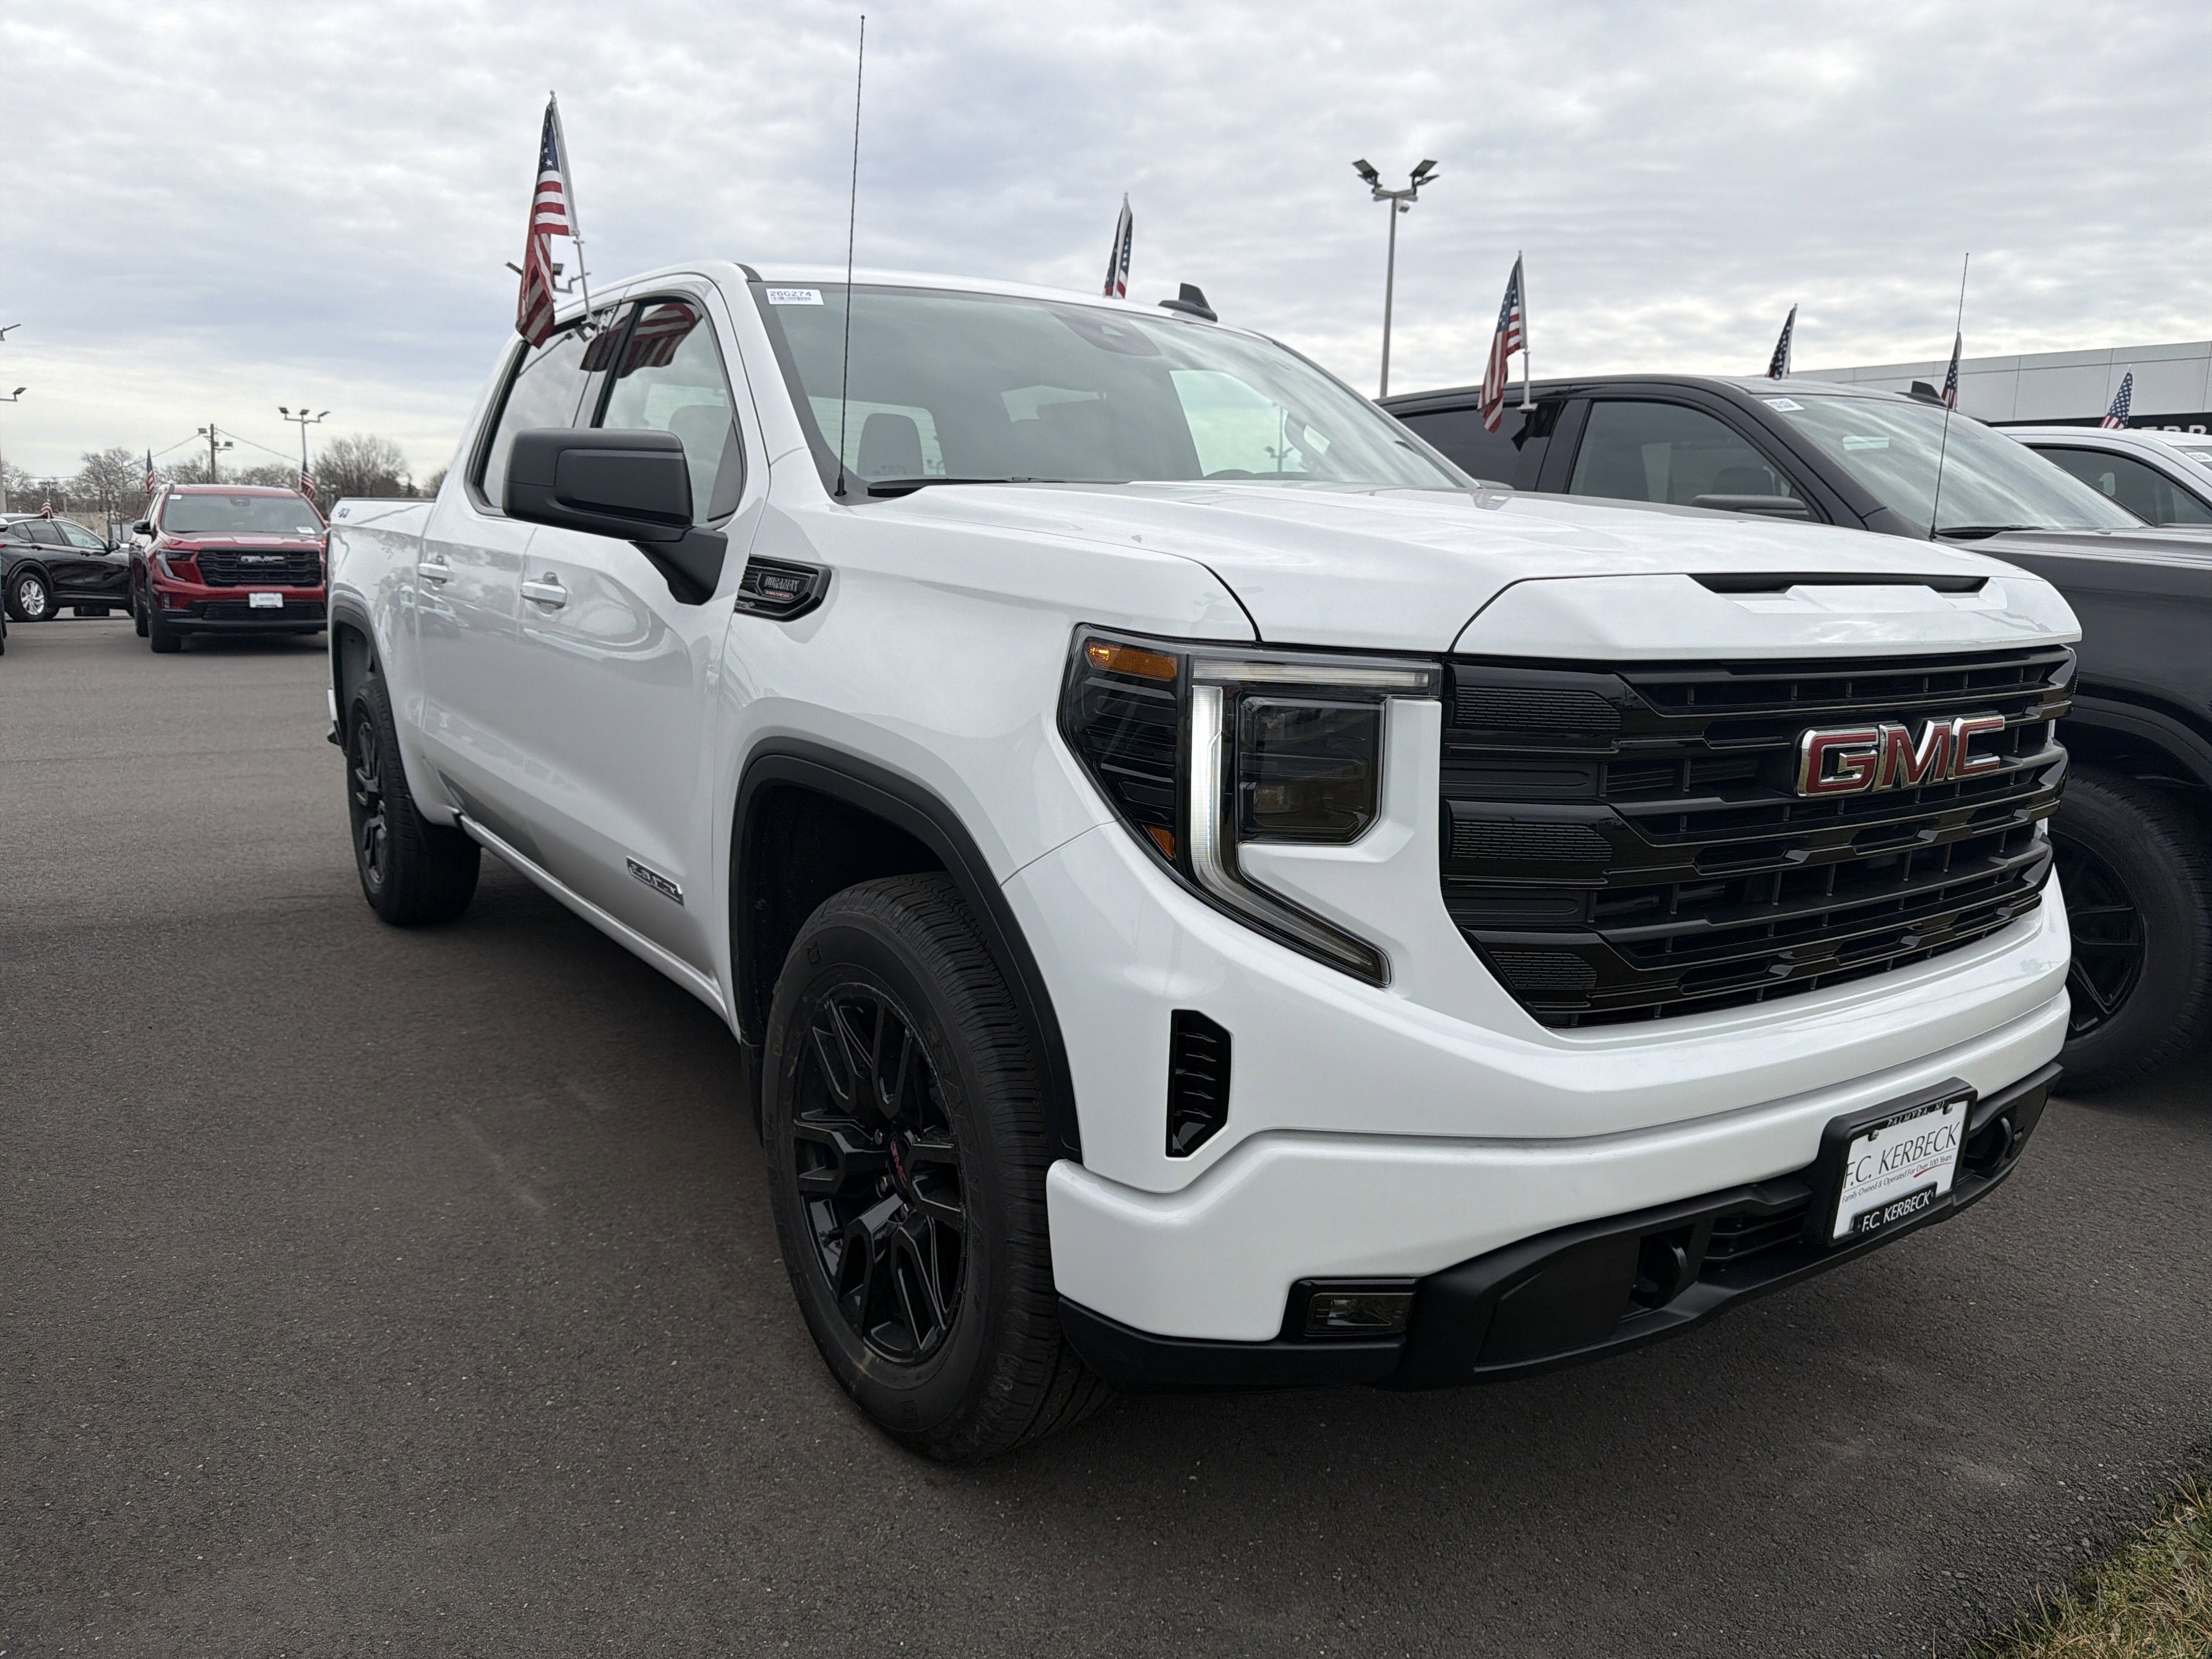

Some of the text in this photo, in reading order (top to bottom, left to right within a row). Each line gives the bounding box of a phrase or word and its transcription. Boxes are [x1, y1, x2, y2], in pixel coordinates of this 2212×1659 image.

[1796, 715, 2005, 797] GMC
[1841, 1189, 1858, 1204] Family
[1858, 1181, 1878, 1197] Owned
[1883, 1170, 1907, 1186] Operated
[1907, 1167, 1916, 1176] For
[1916, 1163, 1929, 1172] Over
[1929, 1158, 1939, 1167] 100
[1939, 1154, 1953, 1164] Years
[1843, 1121, 1961, 1189] F.C. KERBECK
[1861, 1189, 1932, 1233] F.C. KERBECK
